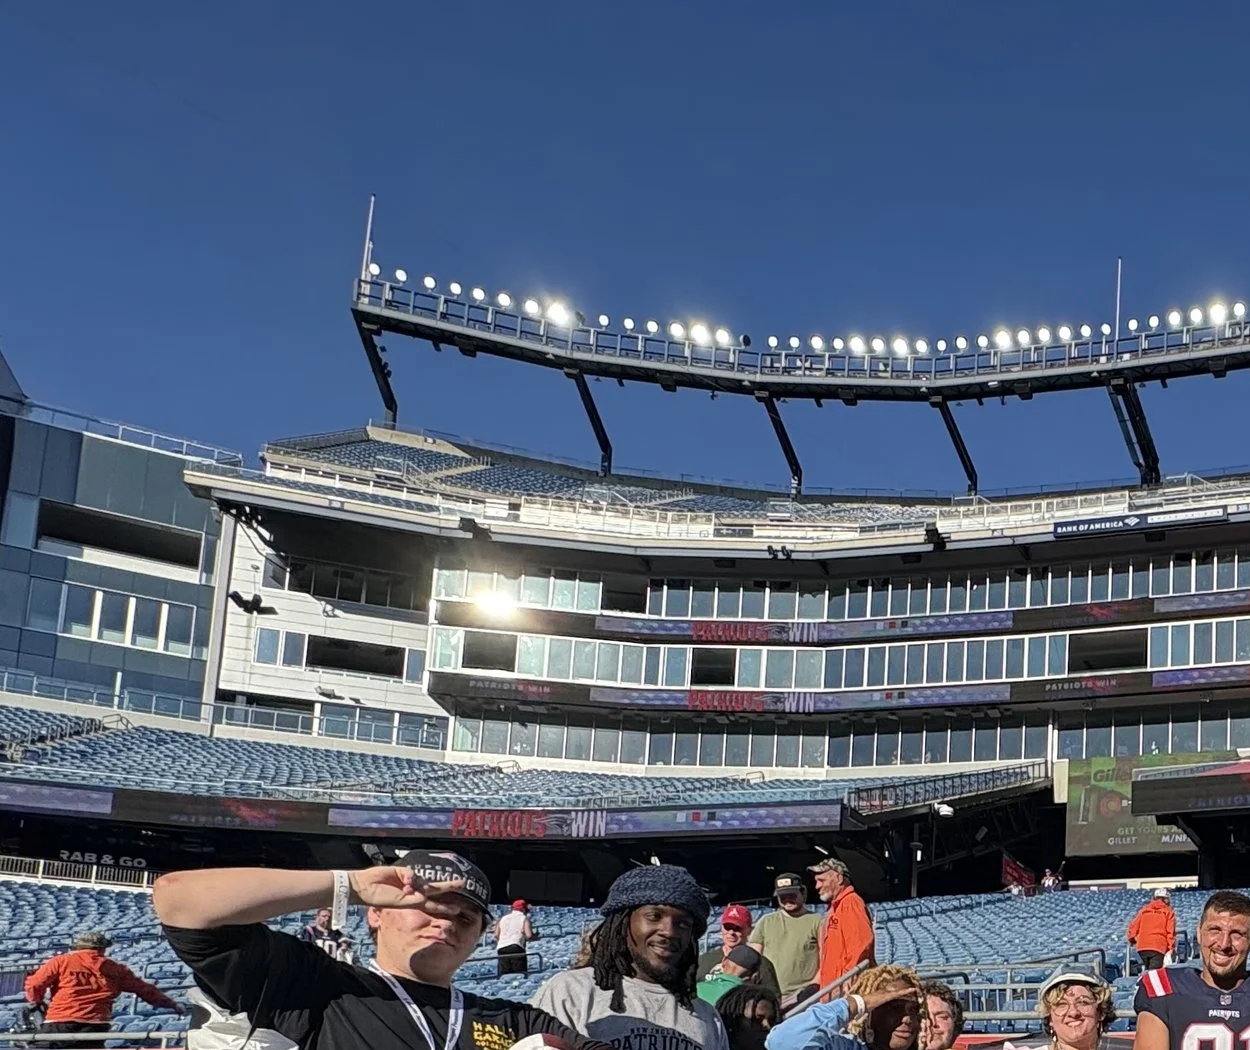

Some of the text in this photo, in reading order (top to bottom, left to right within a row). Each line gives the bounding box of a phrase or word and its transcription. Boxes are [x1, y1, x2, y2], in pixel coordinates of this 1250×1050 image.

[1057, 525, 1078, 533] BANK
[1088, 521, 1124, 530] AMERICA
[789, 622, 818, 642] WIN
[1045, 682, 1093, 691] PATRIOTS
[784, 692, 815, 713] WIN
[452, 809, 607, 837] PATRIOTS WIN
[101, 855, 114, 865] &
[119, 857, 147, 867] GO
[1208, 1009, 1241, 1019] PATRIOTS
